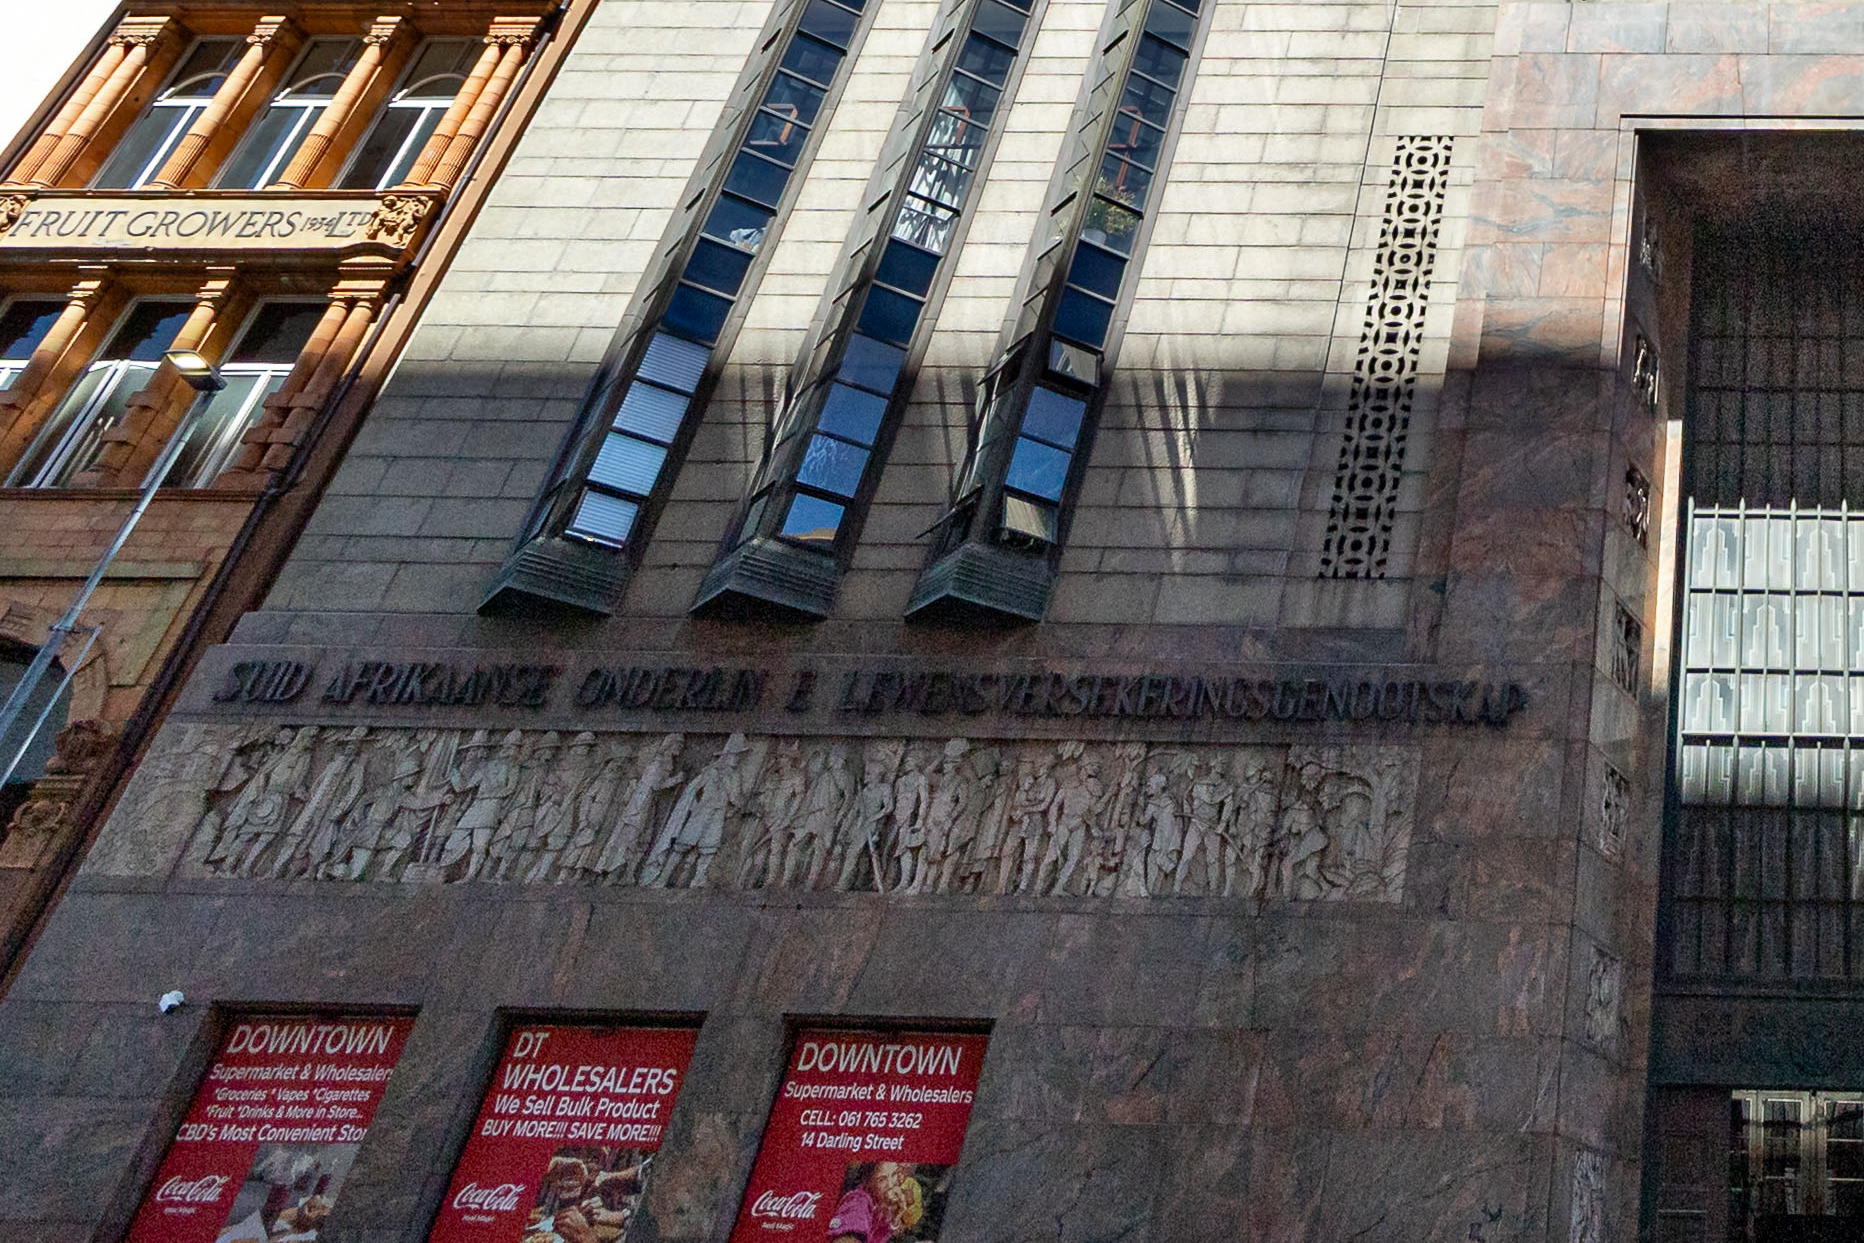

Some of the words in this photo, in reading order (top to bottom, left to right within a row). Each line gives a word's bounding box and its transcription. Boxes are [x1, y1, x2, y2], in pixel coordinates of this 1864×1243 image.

[9, 210, 131, 238] FRUIT
[126, 210, 303, 238] GROWERS
[212, 660, 316, 704] SUID
[319, 661, 560, 709] AFRIKAANSE
[226, 1024, 394, 1055] DOWNTOWN
[513, 1031, 550, 1058] DT
[797, 1042, 963, 1076] DOWNTOWN
[209, 1063, 297, 1083] Supermarket
[299, 1063, 312, 1080] &
[502, 1063, 678, 1096] WHOLESALERS
[783, 1081, 874, 1102] Supermarket
[875, 1083, 886, 1101] &
[890, 1084, 974, 1104] Wholesalers
[285, 1106, 314, 1118] More
[493, 1094, 520, 1114] We
[522, 1095, 555, 1115] Sell
[556, 1096, 594, 1117] Bulk
[595, 1097, 660, 1119] Product
[800, 1110, 837, 1126] CELL:
[838, 1110, 862, 1127] 061
[863, 1111, 888, 1128] 765
[888, 1112, 923, 1129] 3262
[175, 1124, 218, 1142] CBD's
[219, 1124, 257, 1141] Most
[257, 1124, 336, 1142] Convenient
[481, 1119, 514, 1137] BUY
[513, 1120, 568, 1139] MORE!!!
[567, 1122, 606, 1140] SAVE
[605, 1123, 662, 1142] MORE!!!
[801, 1132, 816, 1148] 14
[816, 1132, 864, 1152] Darling
[864, 1133, 905, 1150] Street
[155, 1174, 231, 1202] Coca-Cola
[453, 1182, 527, 1211] Coca-Cola
[751, 1190, 824, 1218] Coca-Cola
